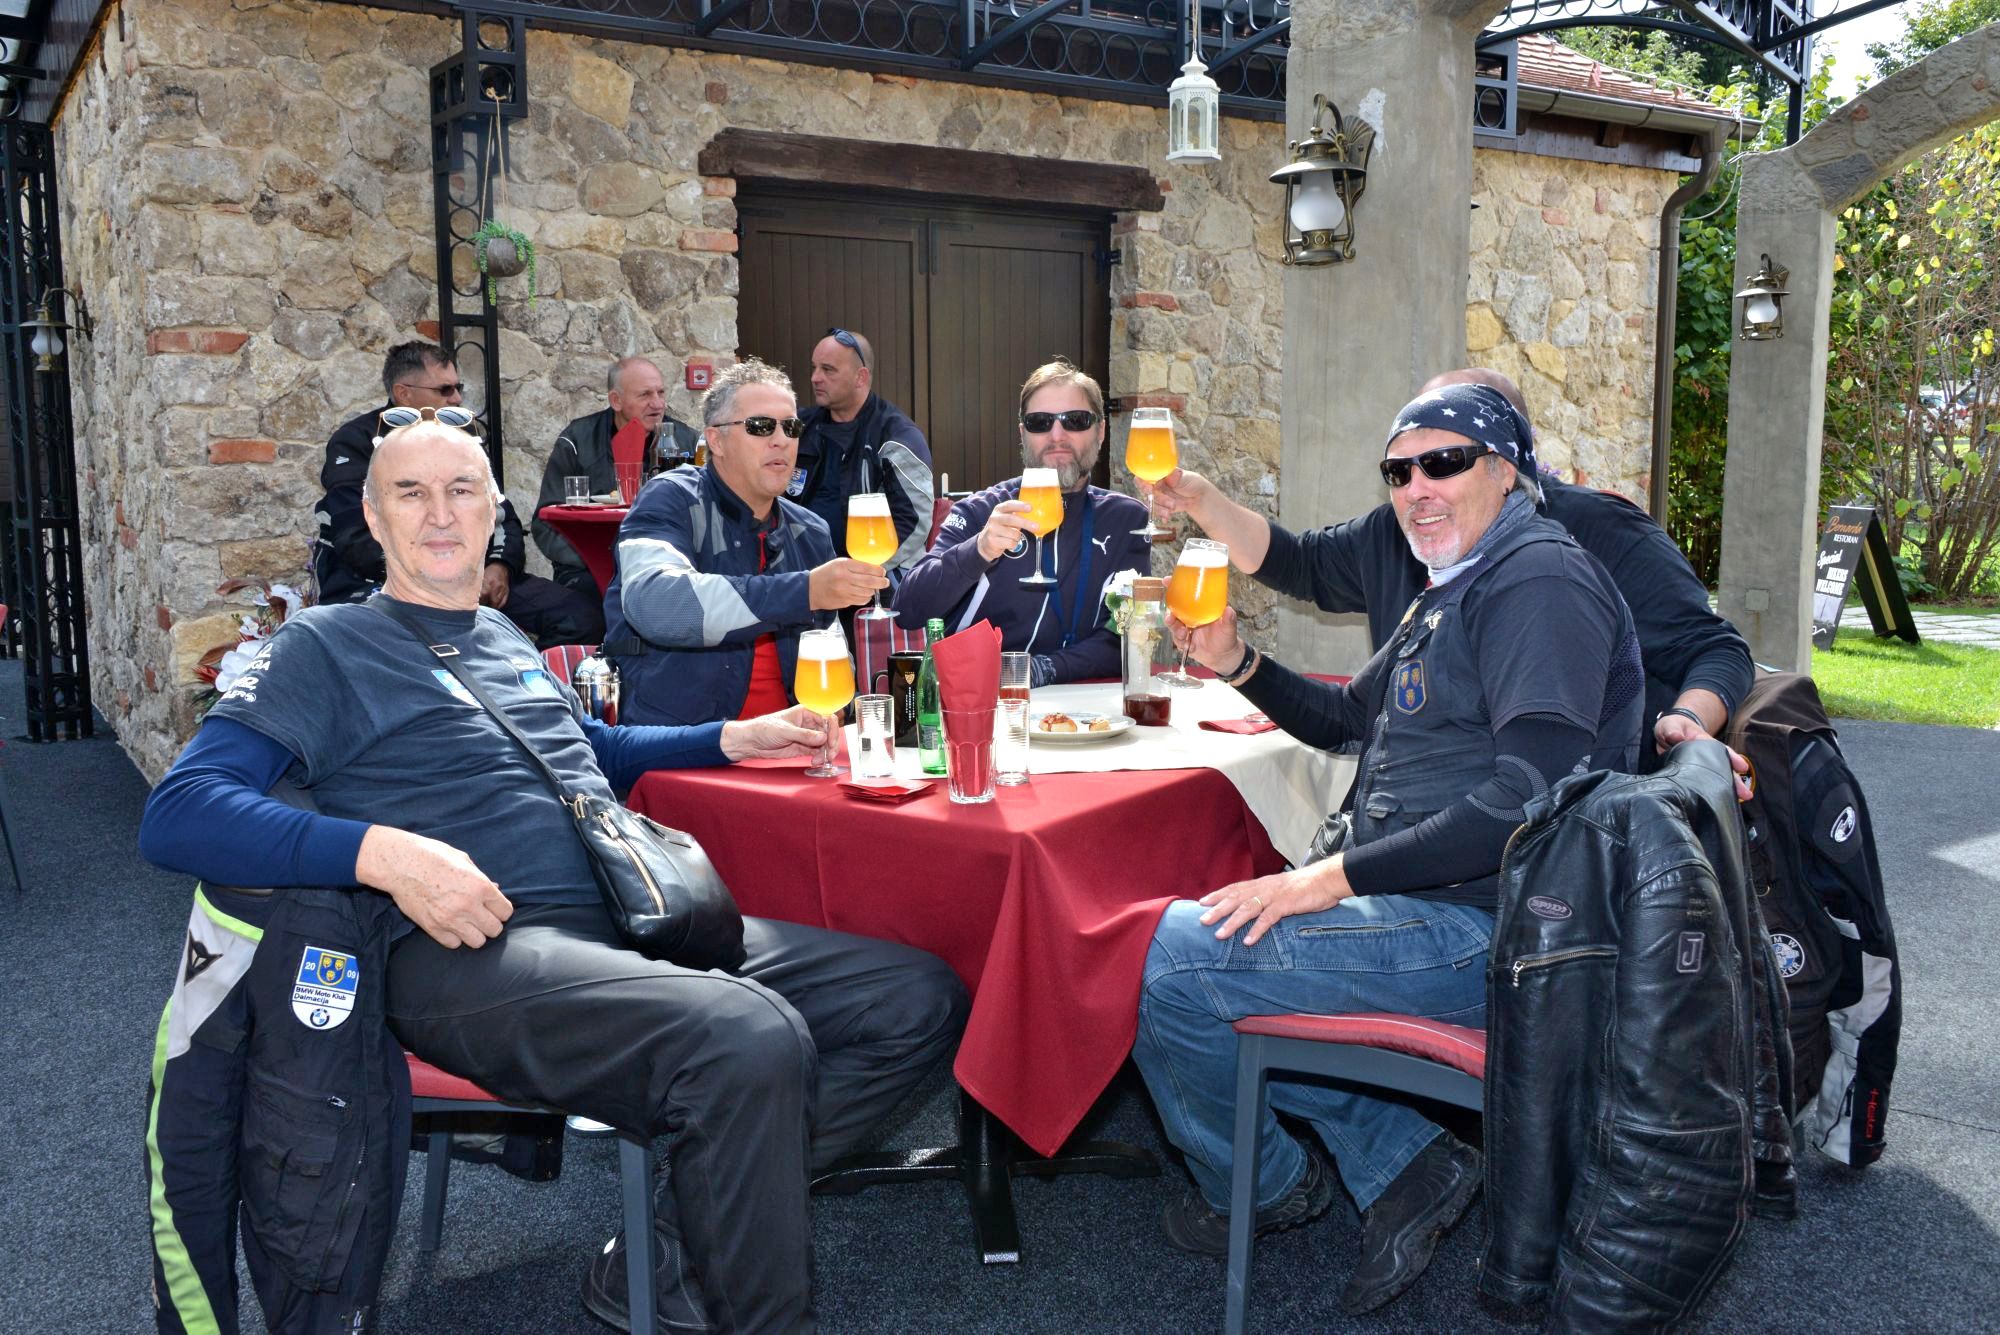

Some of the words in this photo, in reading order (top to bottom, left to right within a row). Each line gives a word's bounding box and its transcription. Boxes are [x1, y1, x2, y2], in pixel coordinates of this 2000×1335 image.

[1833, 533, 1859, 544] RESTORAN
[1816, 549, 1843, 569] Special
[1815, 578, 1845, 596] WELCOME
[304, 961, 316, 971] 20
[346, 969, 356, 979] 09
[293, 993, 329, 1004] Dalmacija
[295, 986, 314, 994] BMW
[314, 989, 331, 998] Moto
[332, 993, 346, 1001] Klub
